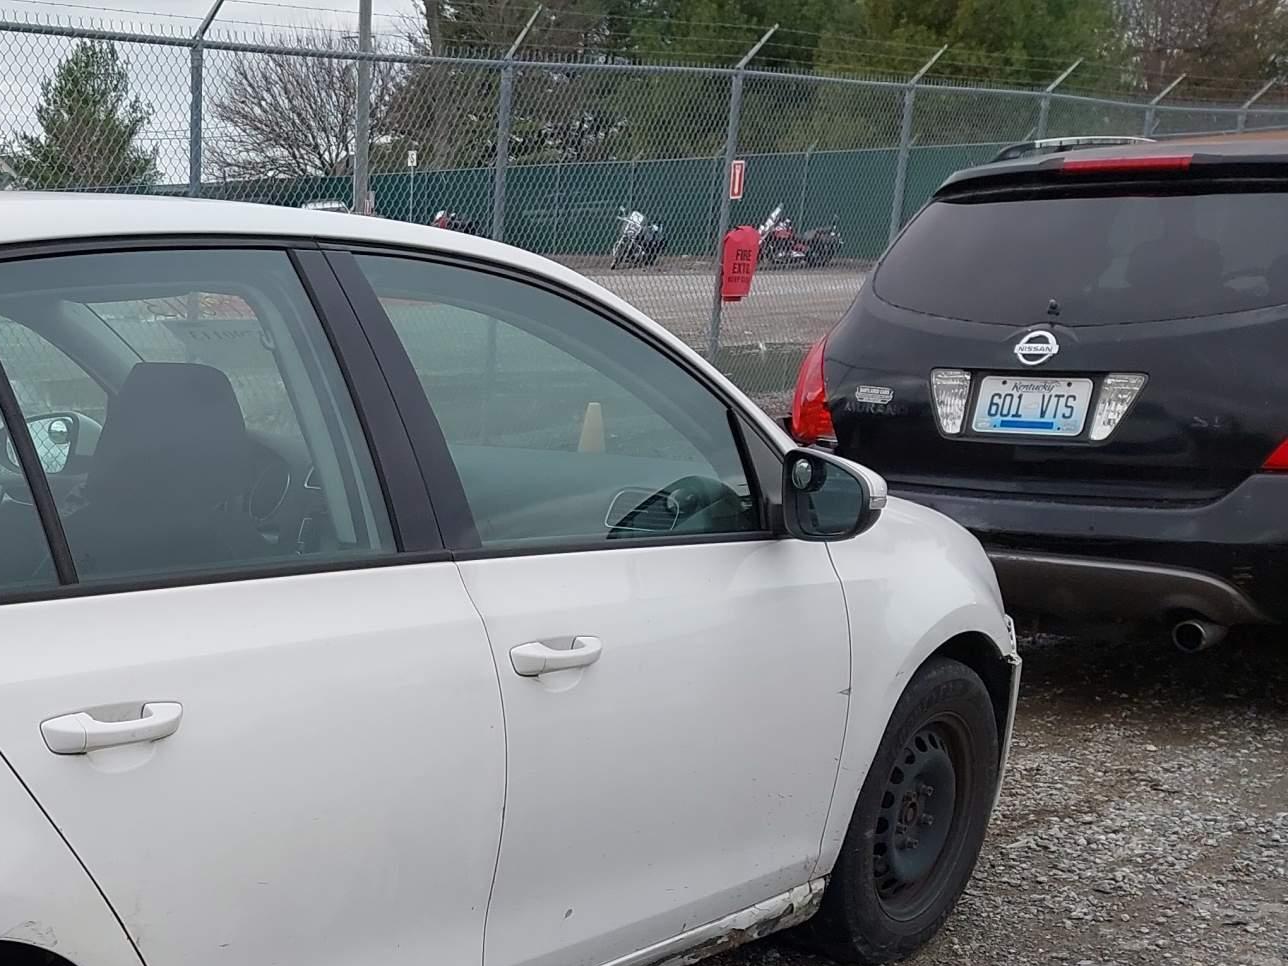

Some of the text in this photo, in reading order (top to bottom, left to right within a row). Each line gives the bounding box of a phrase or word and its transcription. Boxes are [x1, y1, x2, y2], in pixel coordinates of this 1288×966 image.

[735, 249, 752, 261] FIRE
[1012, 381, 1054, 393] Kentucky
[987, 393, 1076, 419] 601 VTS
